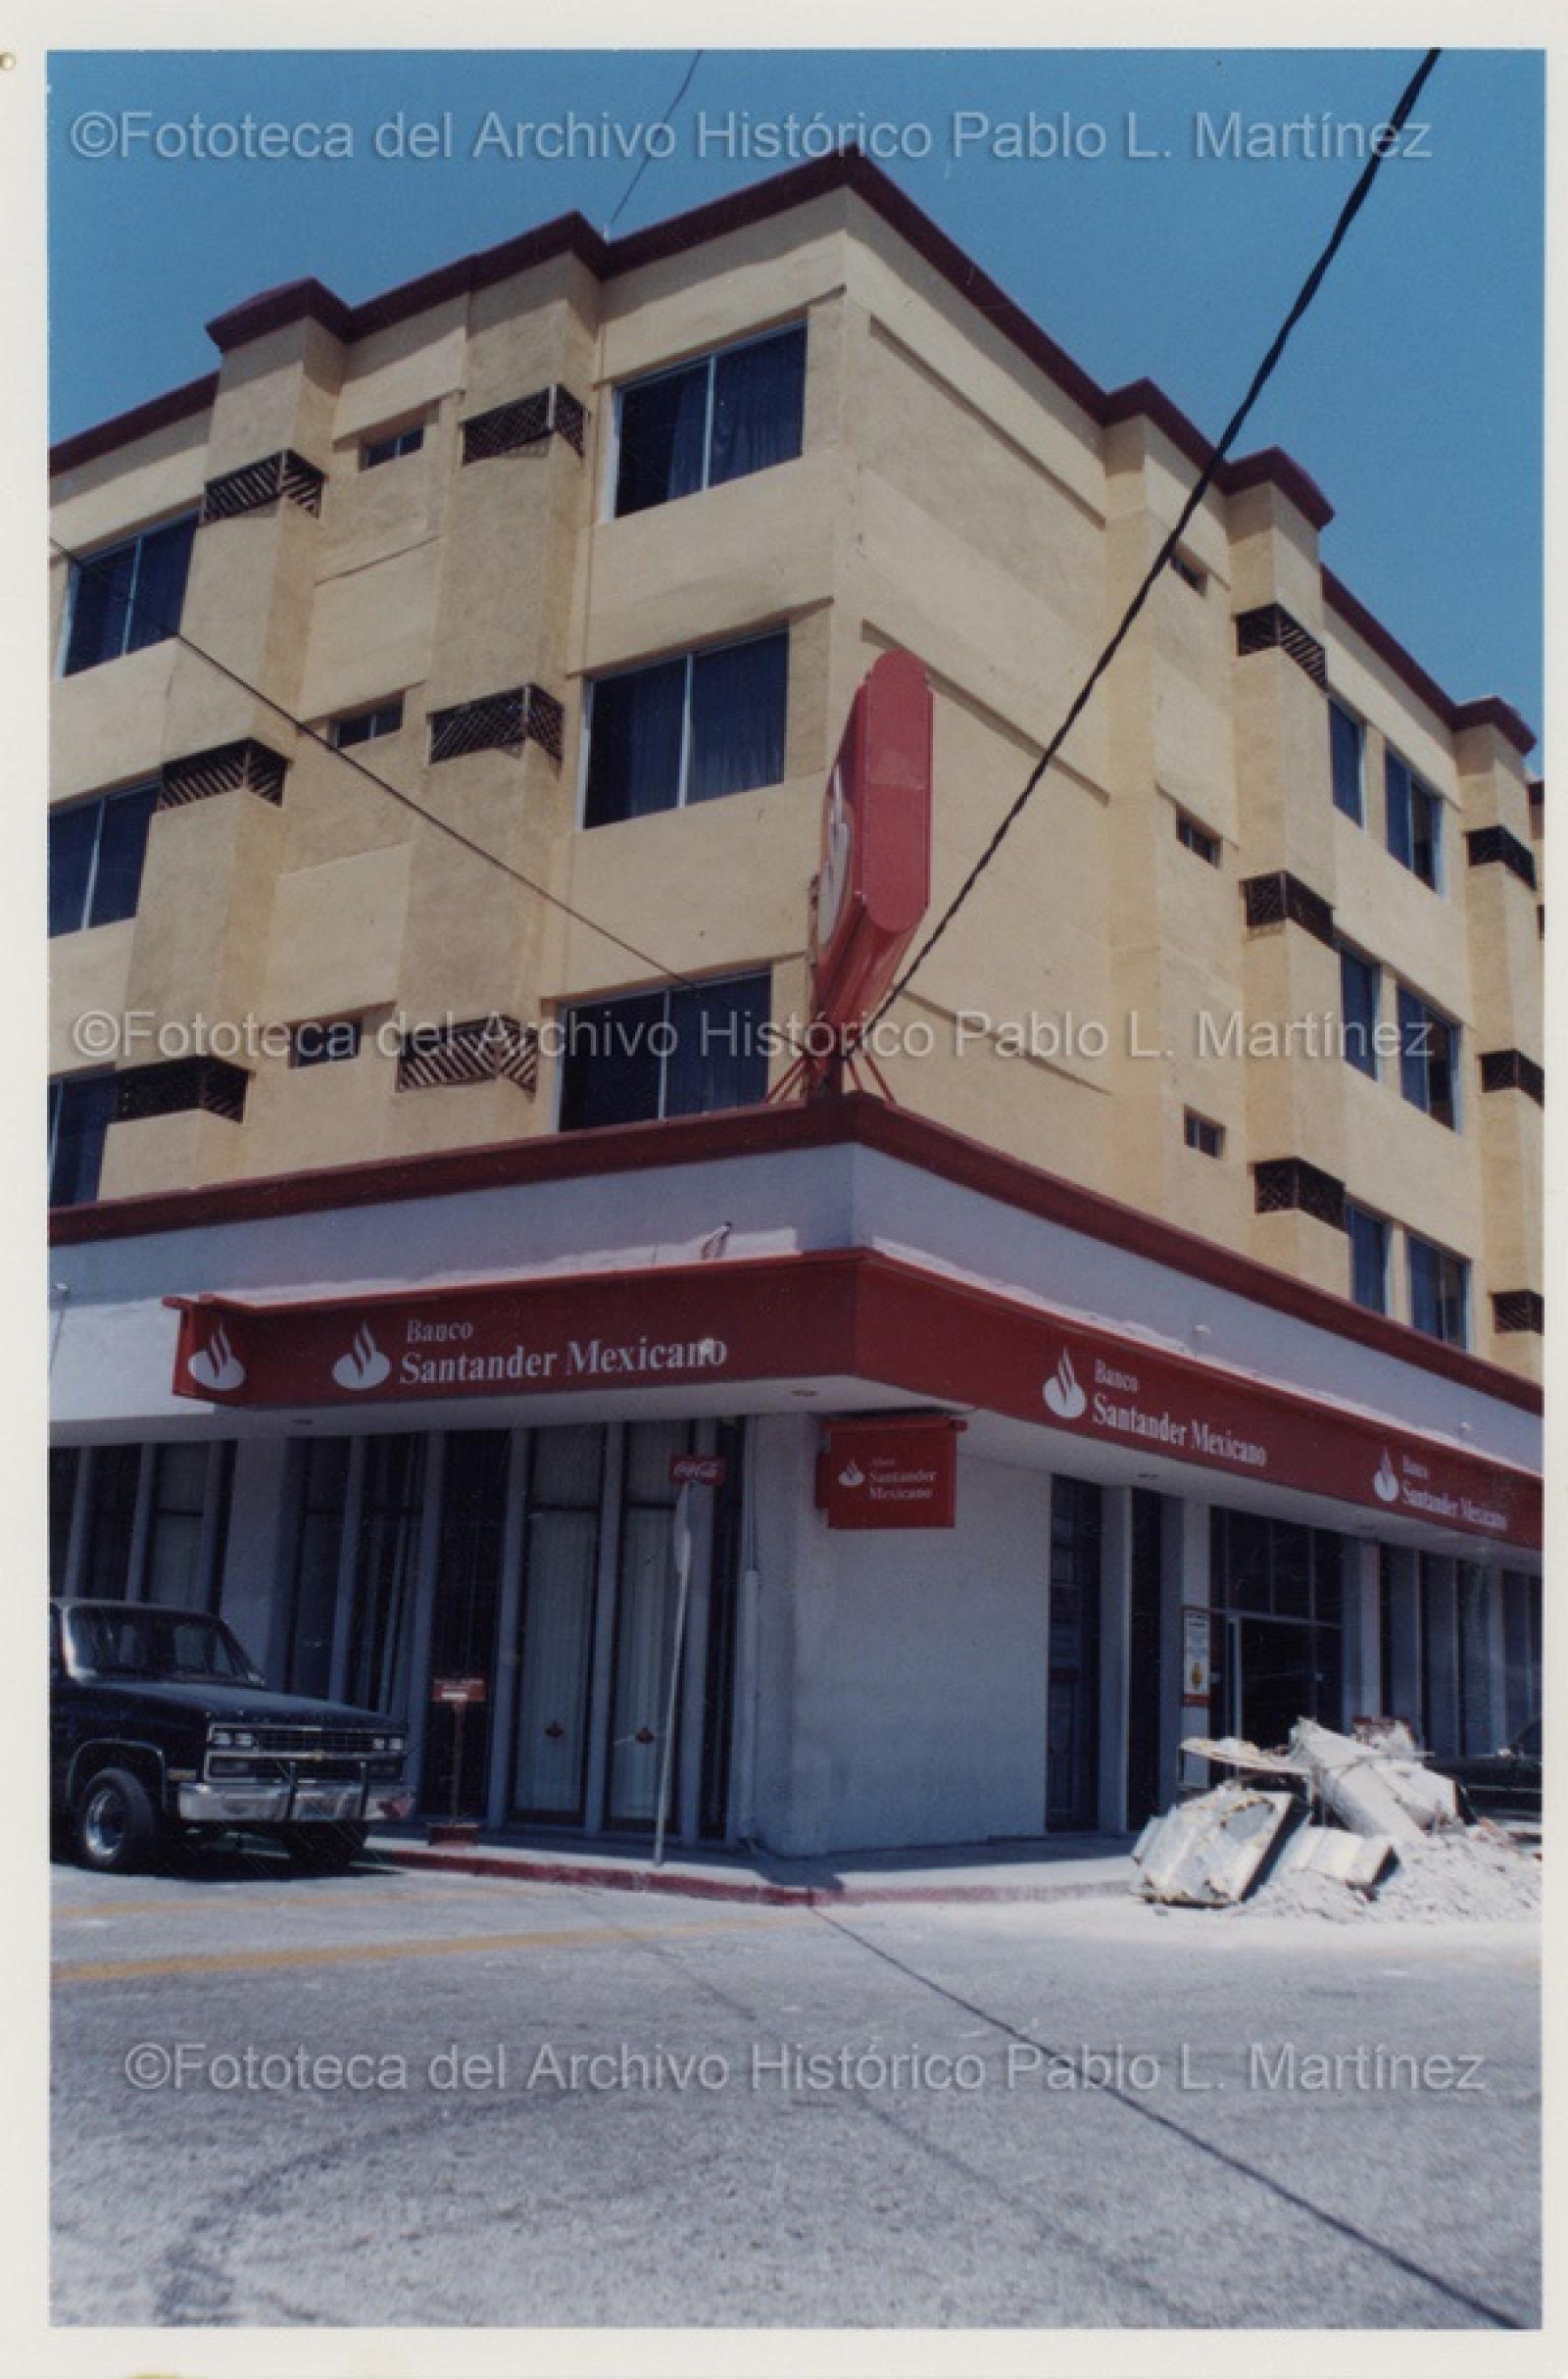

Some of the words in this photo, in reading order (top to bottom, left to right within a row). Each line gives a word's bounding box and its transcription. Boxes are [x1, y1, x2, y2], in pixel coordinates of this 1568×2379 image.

[407, 1319, 473, 1342] Banco
[399, 1345, 557, 1384] Santander
[564, 1336, 728, 1375] Mexicano
[1095, 1359, 1139, 1393] Banco
[1093, 1393, 1187, 1447] Santander
[1191, 1419, 1268, 1466] Mexicano
[869, 1469, 936, 1483] Santander
[869, 1486, 933, 1501] Mexicano
